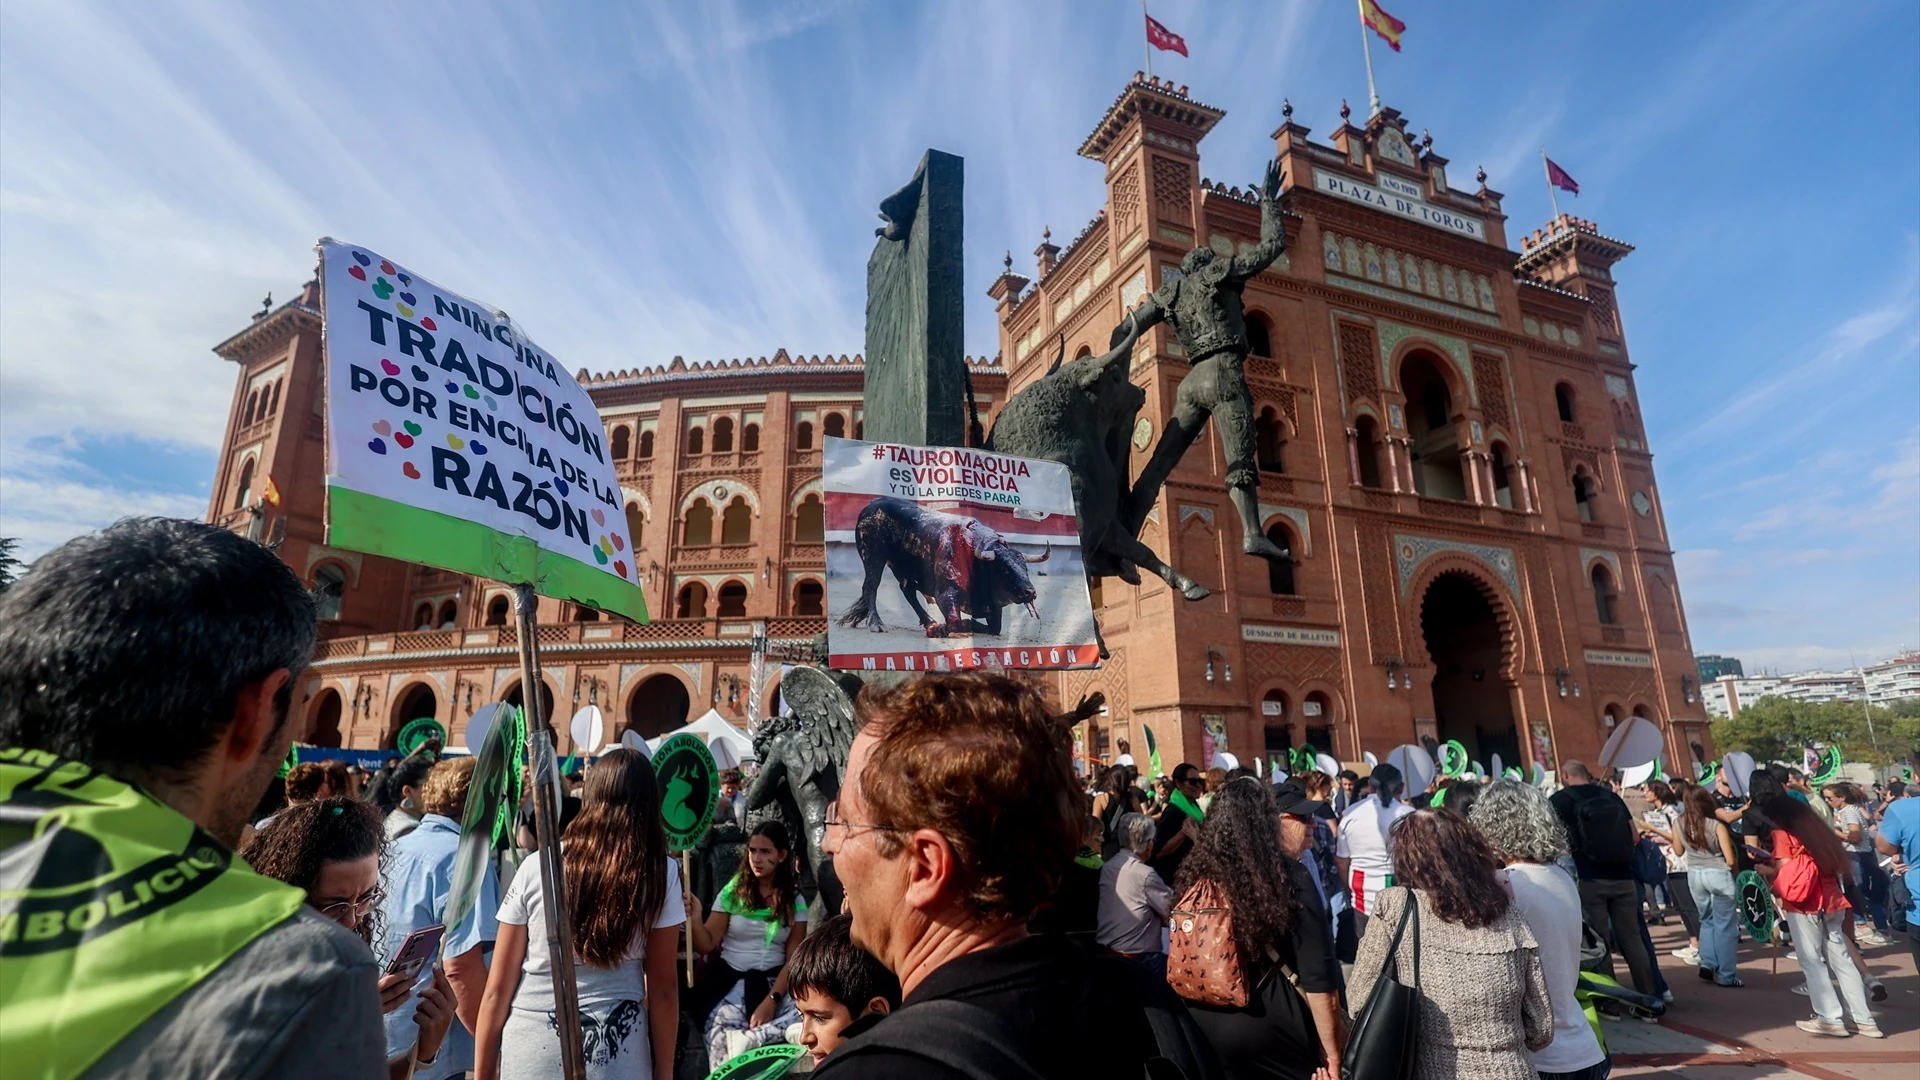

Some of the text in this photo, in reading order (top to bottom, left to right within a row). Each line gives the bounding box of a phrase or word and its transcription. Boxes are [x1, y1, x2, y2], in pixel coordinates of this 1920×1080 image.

[1328, 178, 1475, 234] PLAZA DE TOROS
[357, 299, 604, 465] TRADICIÓN
[350, 363, 438, 420] POR
[560, 458, 589, 493] DE
[592, 477, 619, 510] LA
[872, 445, 1031, 478] #TAUROMAQUIA
[431, 446, 591, 546] RAZÓN
[889, 467, 1019, 493] esVIOLENCIA
[889, 482, 1021, 505] Y TÚ LA PUEDES PARAR
[1287, 632, 1297, 640] DE
[862, 647, 1077, 671] MANIFESTACIÓN
